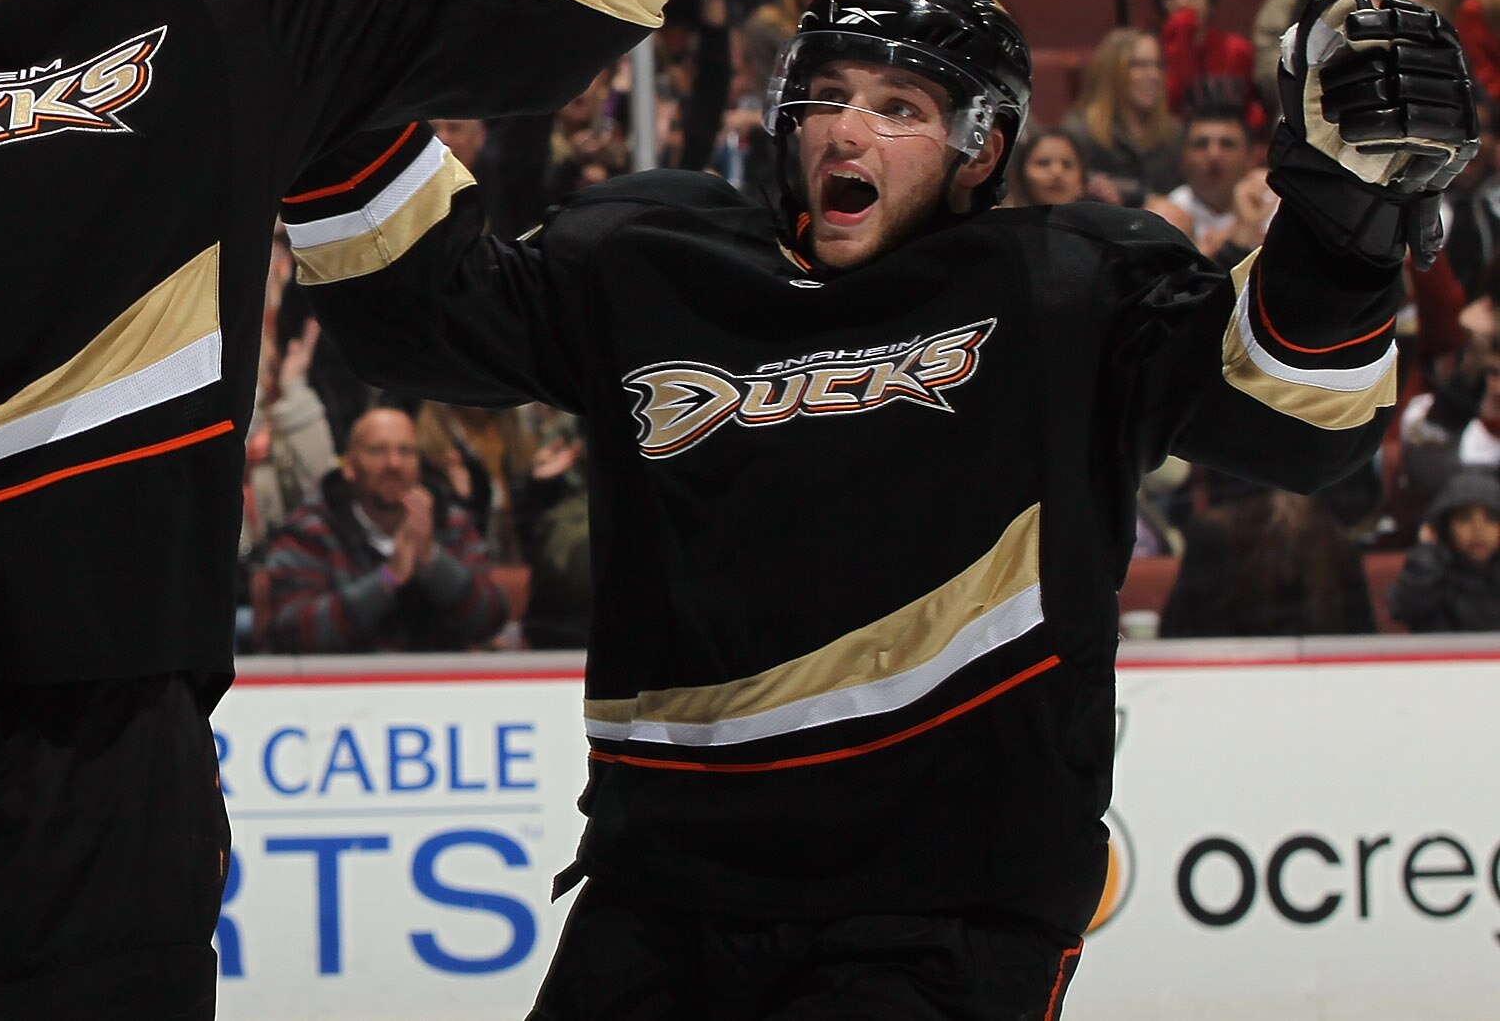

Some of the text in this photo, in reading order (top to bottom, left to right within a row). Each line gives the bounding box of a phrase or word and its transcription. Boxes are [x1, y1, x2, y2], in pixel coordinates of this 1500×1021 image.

[621, 318, 997, 459] DUCKS
[755, 336, 921, 373] ANAHEIM
[261, 722, 537, 796] CABLE
[1176, 834, 1500, 947] ocre
